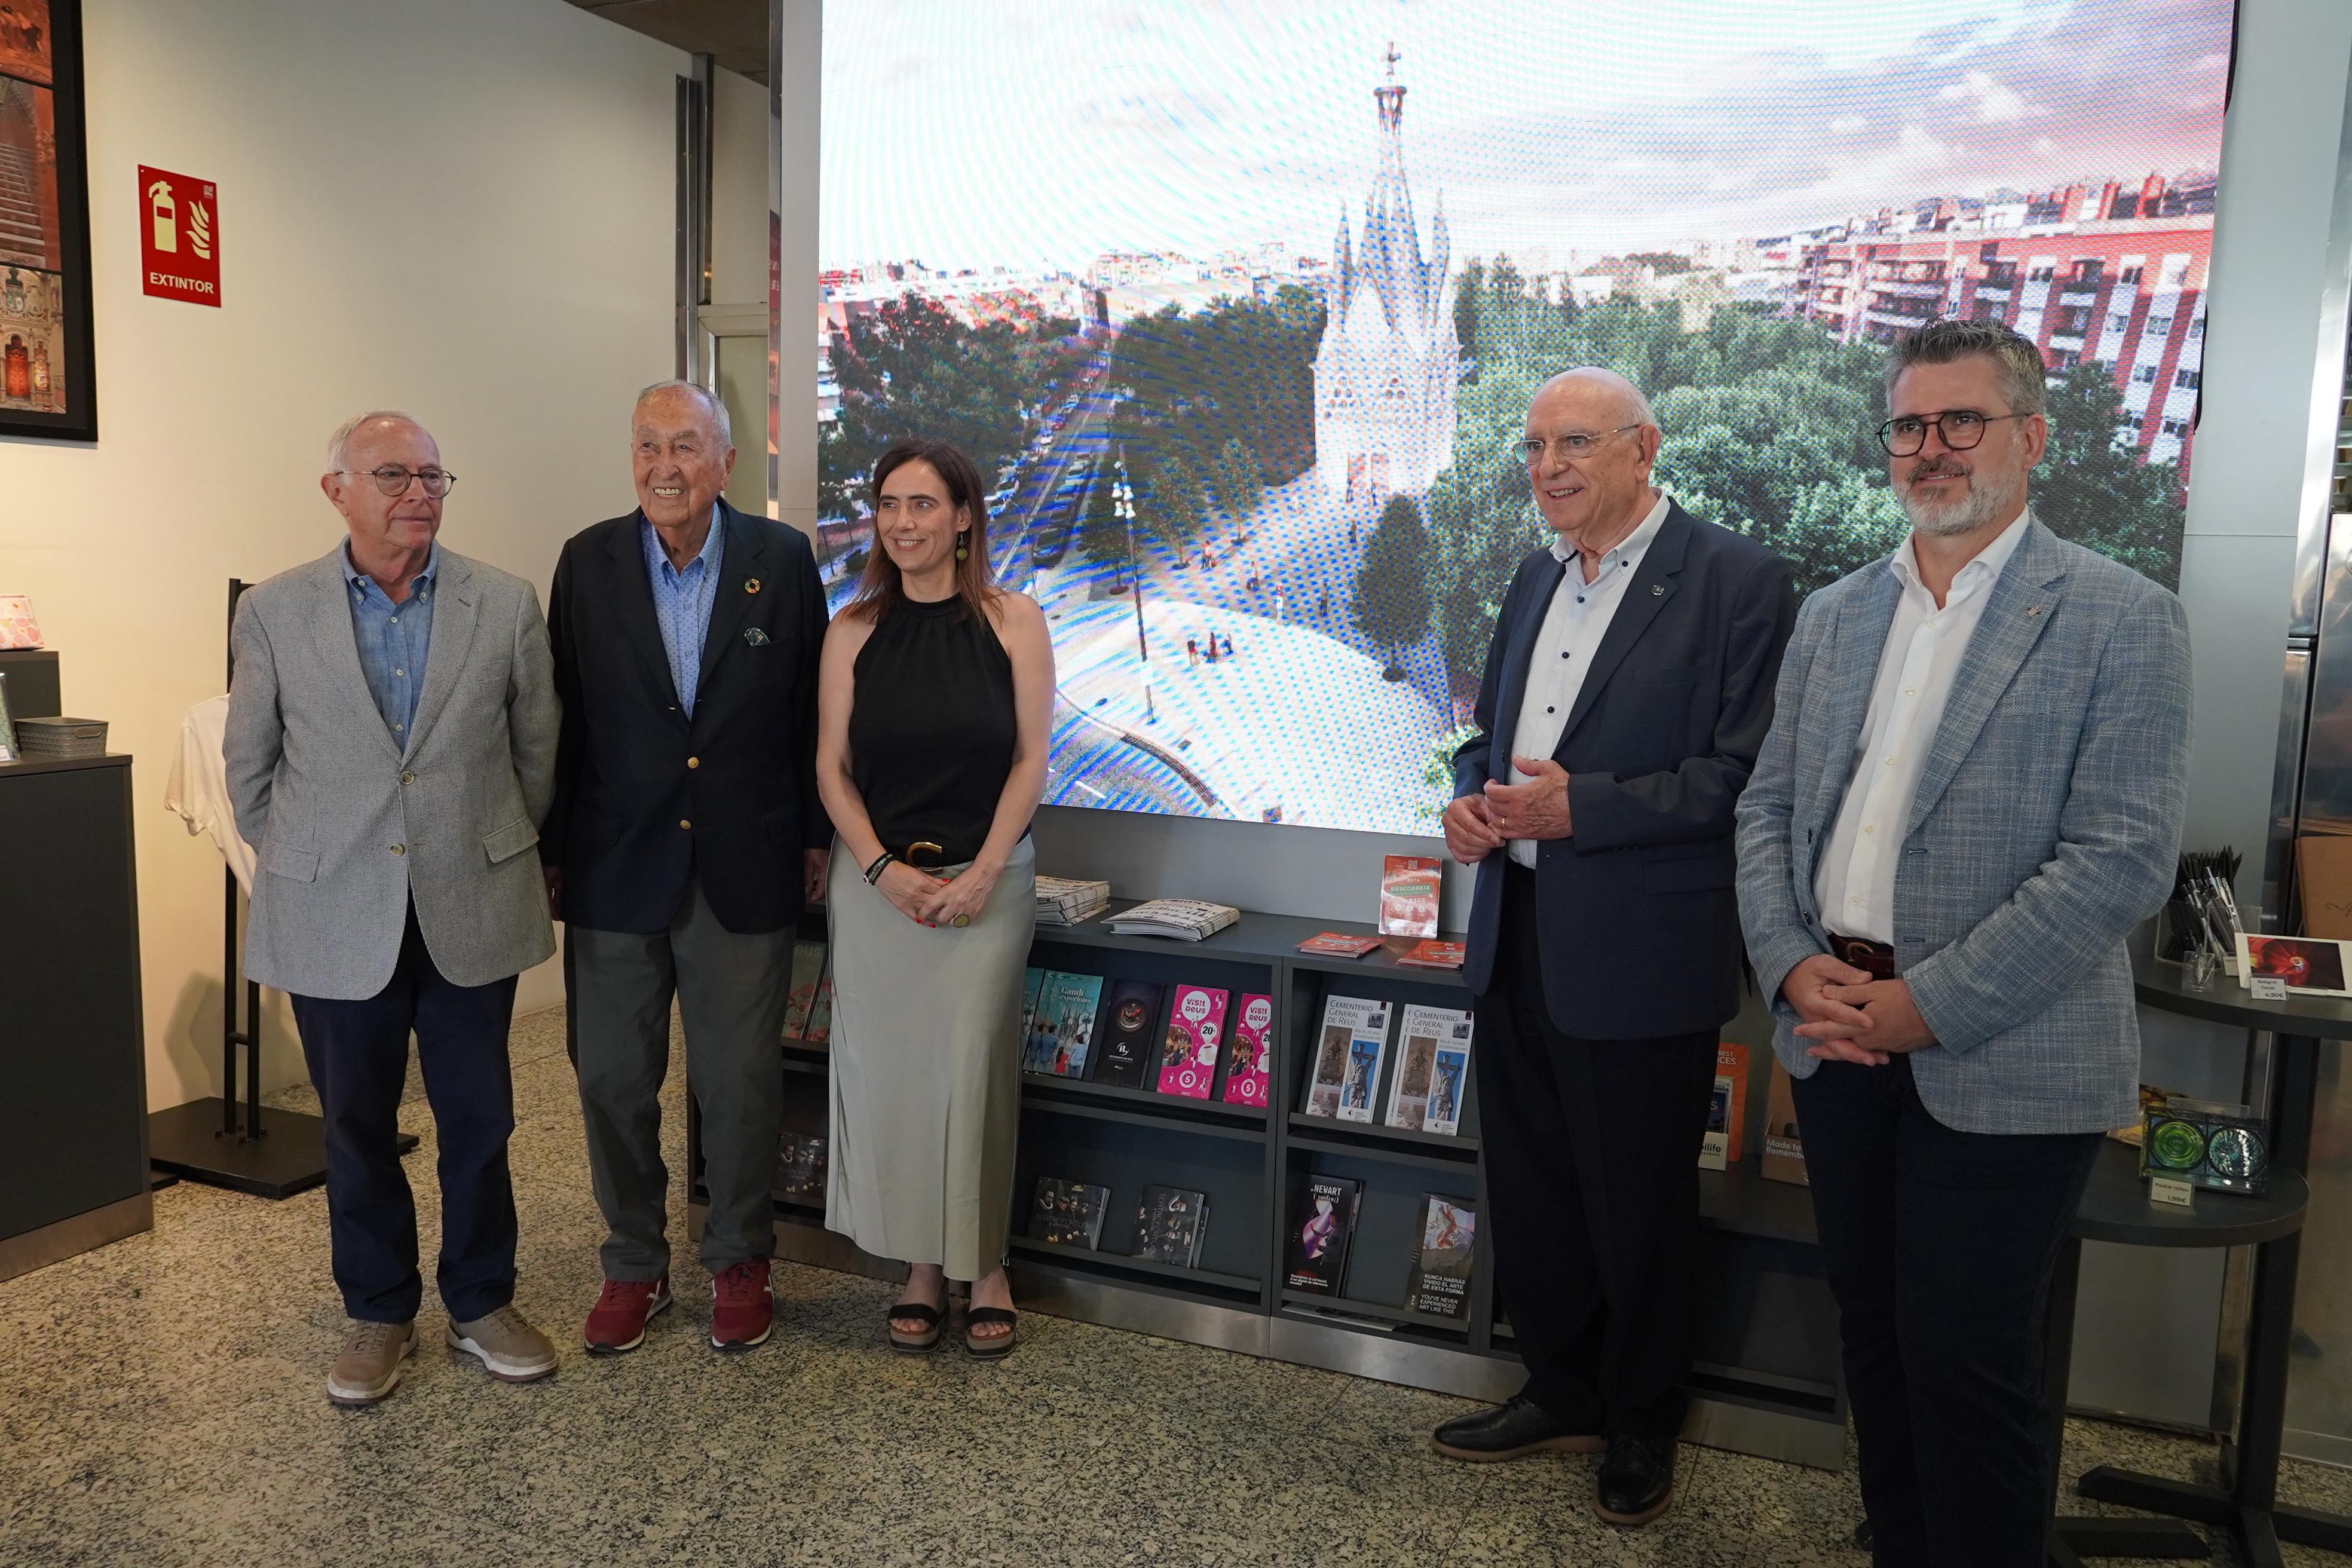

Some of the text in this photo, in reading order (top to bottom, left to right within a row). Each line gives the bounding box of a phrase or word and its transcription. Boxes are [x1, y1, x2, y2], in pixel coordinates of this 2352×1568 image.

[149, 272, 214, 294] EXTINTOR
[794, 945, 822, 957] eus
[1059, 994, 1094, 1004] experience
[1330, 1000, 1373, 1012] CEMENTERIO
[1329, 1007, 1359, 1018] GENERAL
[1414, 1010, 1458, 1022] CEMENTERIO
[1339, 1017, 1356, 1026] REUS
[1413, 1018, 1444, 1028] GENERAL
[1423, 1027, 1441, 1036] REUS
[1717, 1056, 1737, 1065] ICES
[1702, 1143, 1722, 1152] ilife
[1766, 1139, 1791, 1150] Made
[1445, 1287, 1465, 1296] FORMA
[1420, 1298, 1456, 1309] EXPERIENCED
